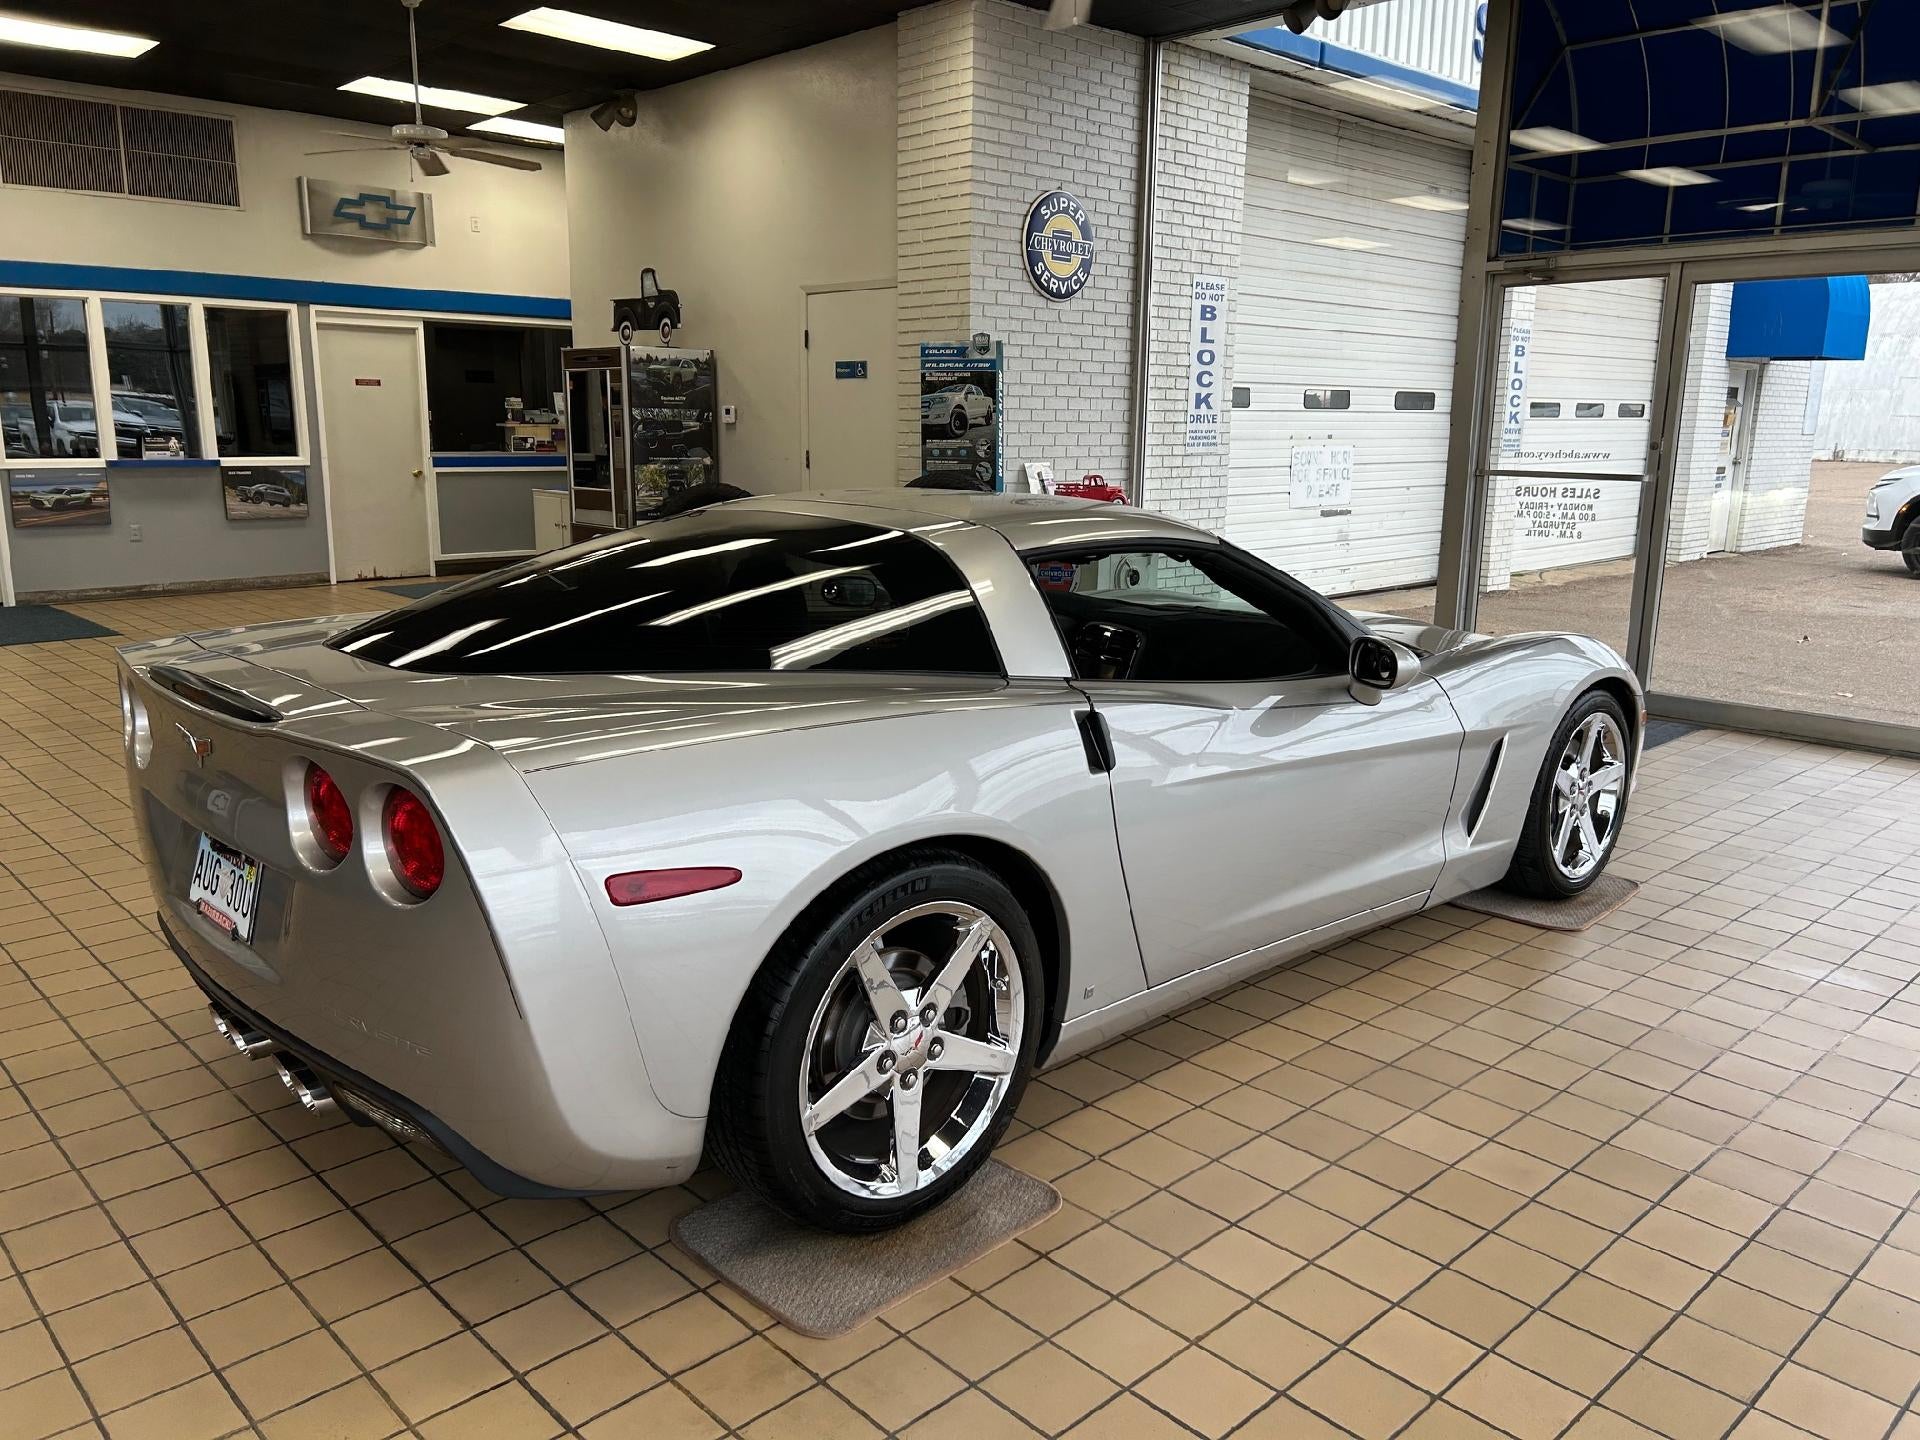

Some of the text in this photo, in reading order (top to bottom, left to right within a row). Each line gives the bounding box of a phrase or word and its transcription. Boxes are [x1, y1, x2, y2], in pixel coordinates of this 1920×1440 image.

[1040, 197, 1086, 226] SUPER
[1034, 235, 1090, 256] CHEVROLET
[1034, 262, 1088, 295] SERVICE
[1195, 281, 1226, 291] PLEASE
[1195, 292, 1225, 302] DO NOT
[1512, 327, 1531, 335] PLEASE
[1195, 304, 1218, 410] BLOCK
[1508, 344, 1526, 424] BLOCK
[1189, 414, 1218, 424] DRIVE
[1293, 450, 1323, 466] SOUN
[1306, 483, 1341, 498] PEASE
[193, 849, 222, 896] AUG
[838, 876, 928, 944] ICHELIN
[321, 1003, 433, 1057] RVETTE
